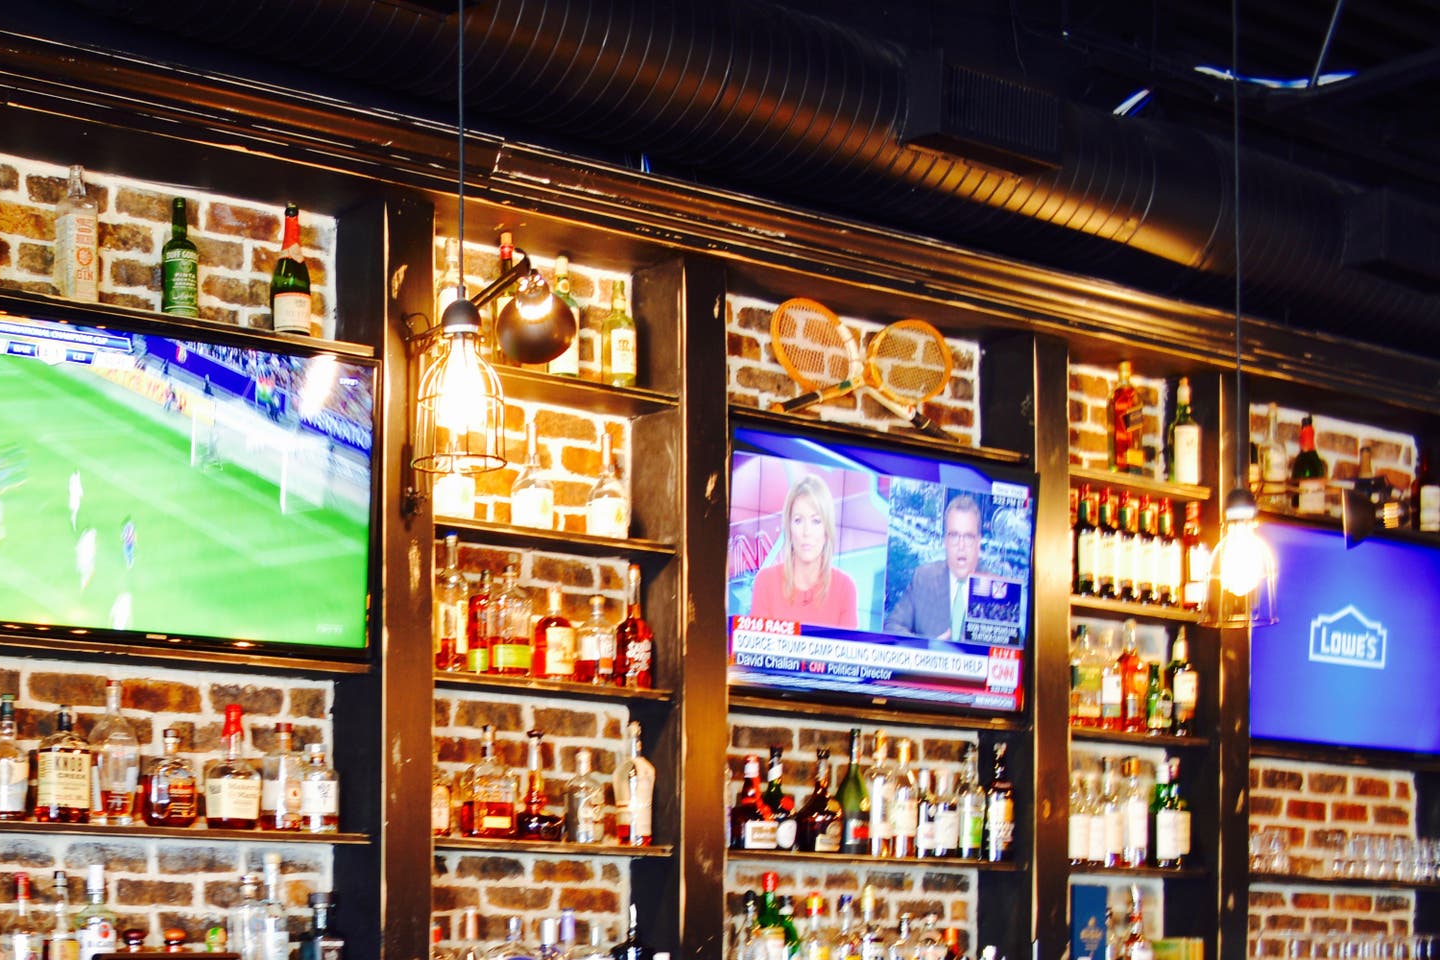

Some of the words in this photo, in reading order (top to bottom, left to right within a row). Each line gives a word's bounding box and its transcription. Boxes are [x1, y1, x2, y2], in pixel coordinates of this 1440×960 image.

[76, 269, 93, 280] GIN
[51, 331, 92, 343] CHAMPIONS
[93, 336, 109, 345] CUP
[737, 616, 763, 631] 2016
[765, 619, 795, 635] RACE
[778, 638, 807, 654] TRUMP
[809, 641, 833, 656] CAMP
[835, 645, 869, 661] CALLING
[914, 653, 949, 669] CHRISTIE
[951, 656, 962, 670] TO
[963, 657, 983, 672] HELP
[992, 647, 1016, 658] LIVE
[736, 653, 763, 668] David
[764, 656, 800, 671] Chalian
[809, 661, 827, 673] CNN
[827, 663, 860, 677] Political
[860, 666, 893, 681] Director
[992, 663, 1015, 682] CNN
[54, 755, 83, 772] KNOB
